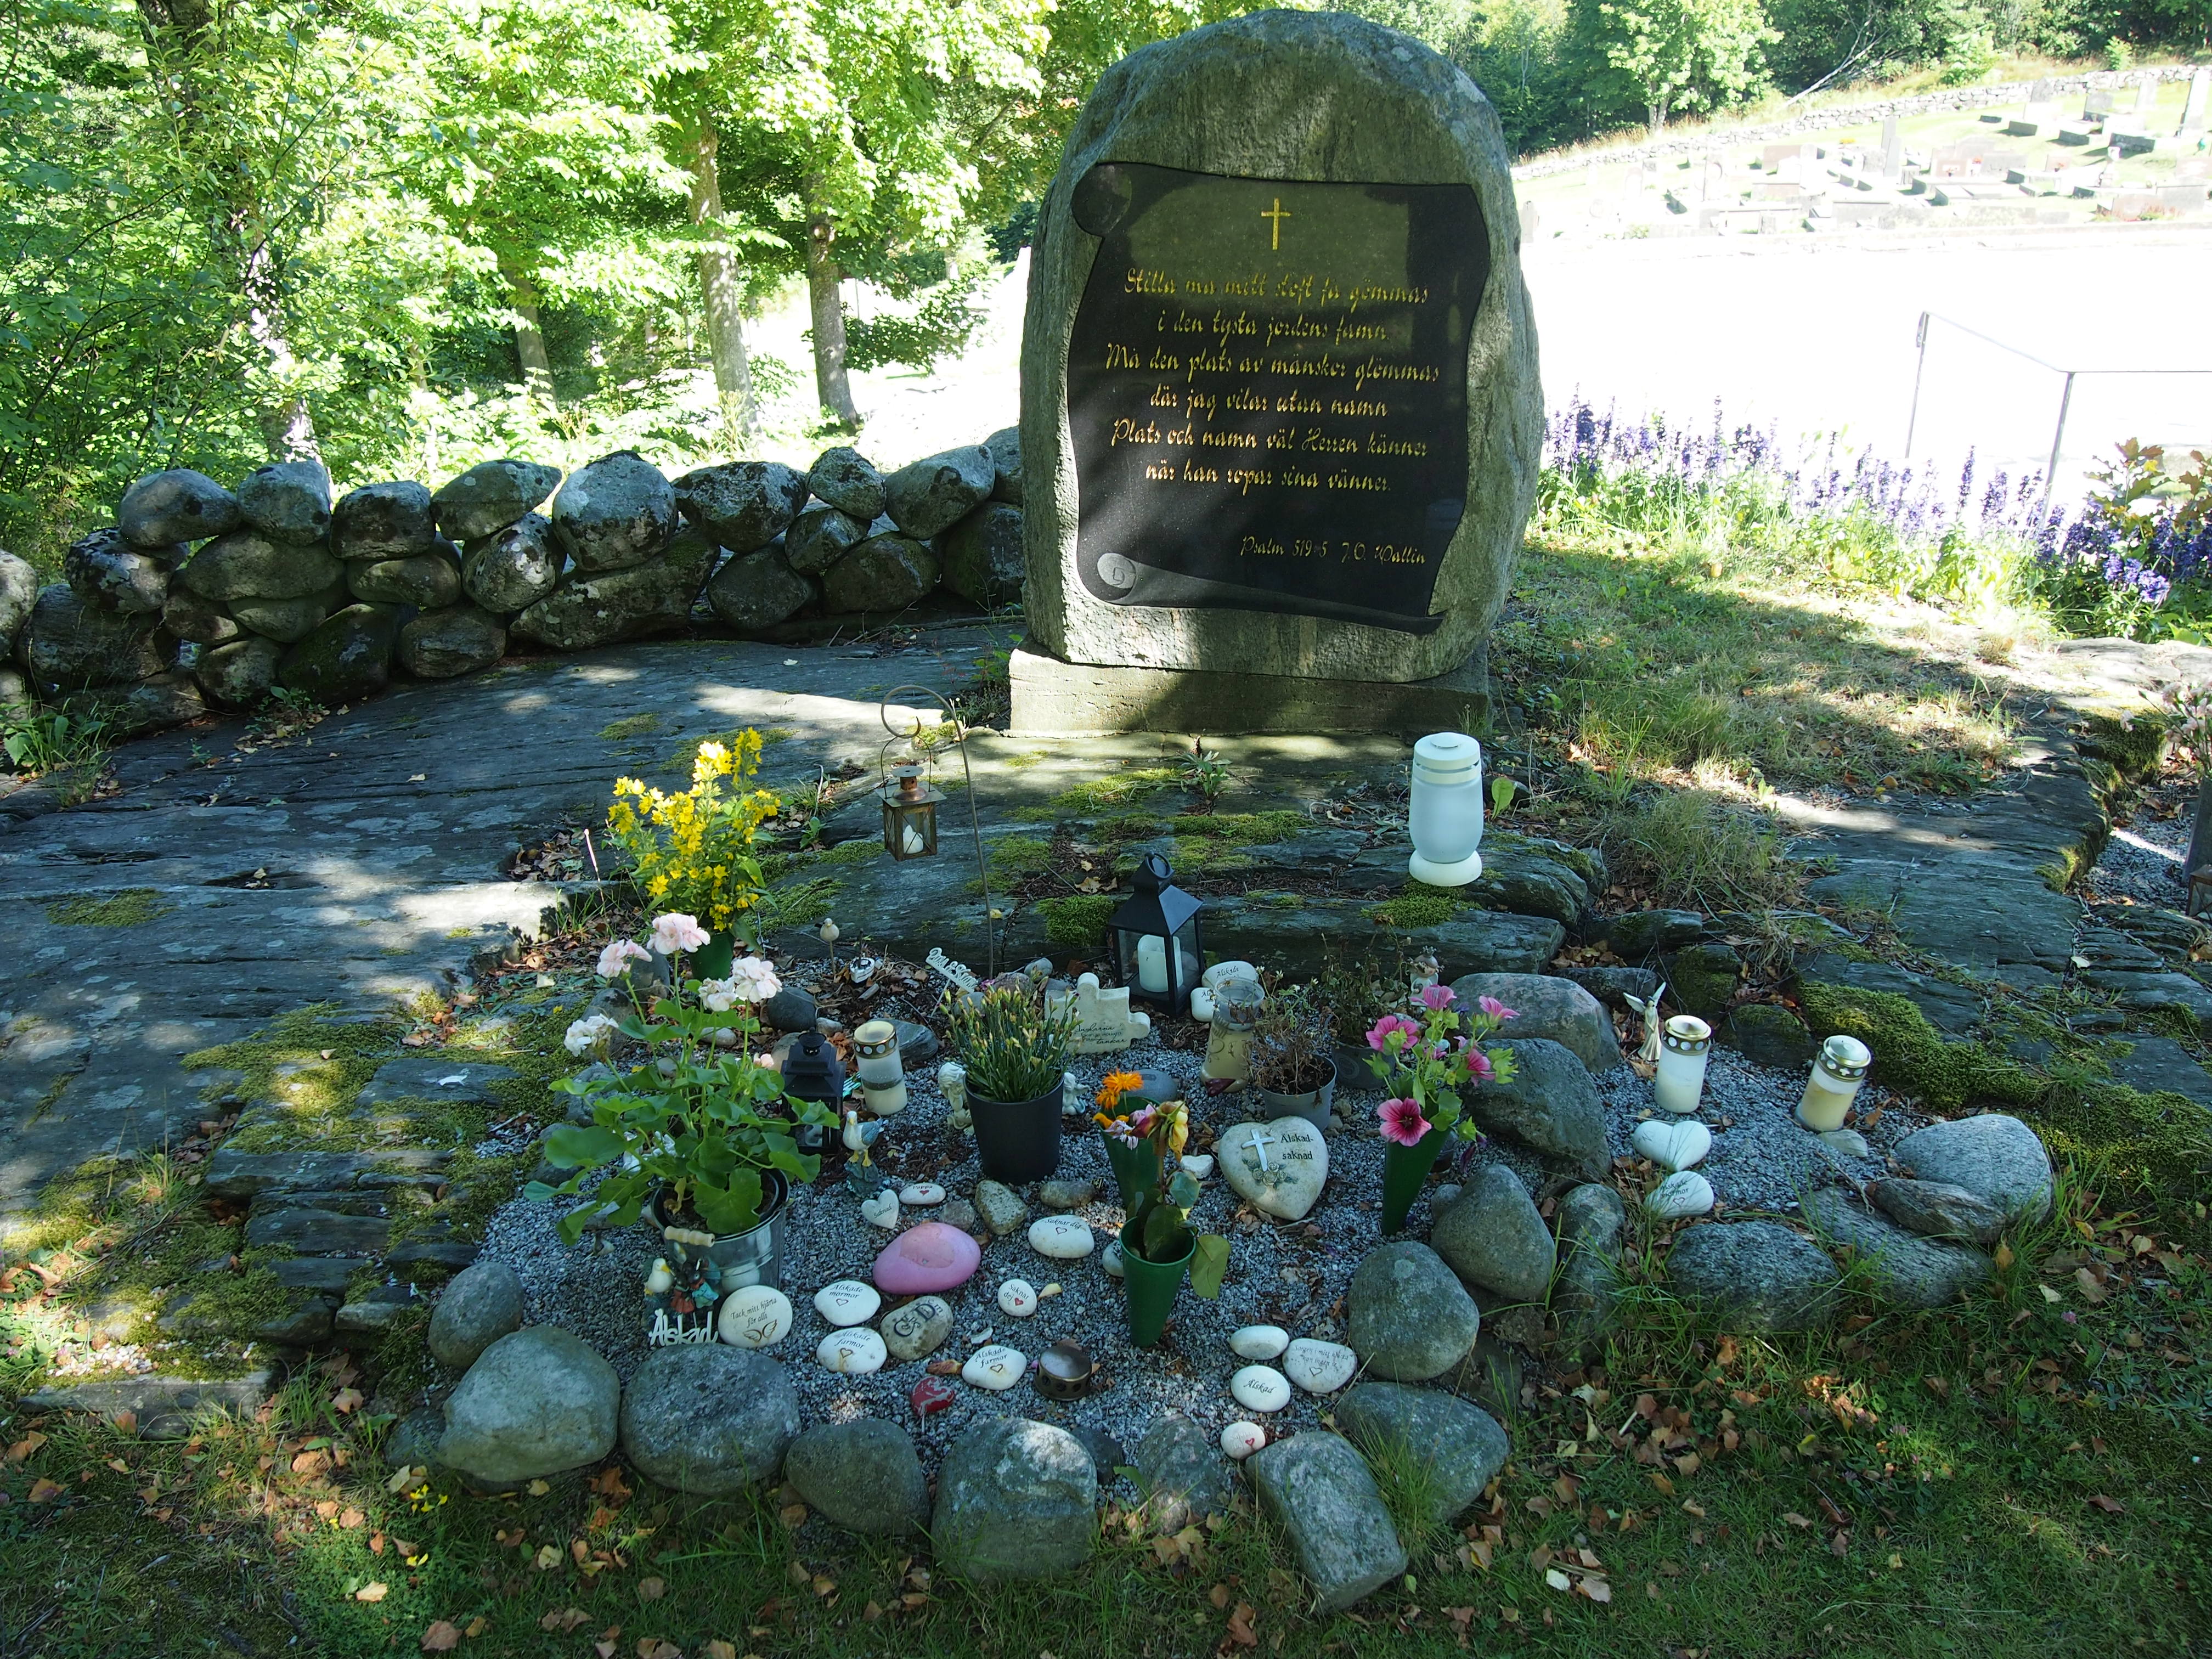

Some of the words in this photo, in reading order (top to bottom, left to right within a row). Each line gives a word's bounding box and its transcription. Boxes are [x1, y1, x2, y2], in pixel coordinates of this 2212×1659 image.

[1125, 268, 1177, 294] Stilla
[1225, 273, 1267, 296] mitt
[1349, 278, 1427, 314] gömmas
[1158, 309, 1166, 332] i
[1174, 308, 1203, 332] den
[1214, 309, 1257, 347] tysta
[1266, 313, 1328, 347] jordens
[1105, 342, 1141, 369] Må
[1150, 345, 1180, 370] den
[1187, 347, 1232, 383] plats
[1239, 357, 1263, 373] av
[1271, 353, 1346, 377] mänskor
[1355, 354, 1440, 392] glömmas
[1150, 383, 1178, 407] där
[1186, 388, 1217, 421] jag
[1227, 386, 1268, 411] vilar
[1277, 388, 1323, 413] utan
[1111, 418, 1161, 447] Plats
[1167, 421, 1194, 445] och
[1202, 432, 1257, 449] namn
[1266, 426, 1295, 450] väl
[1301, 427, 1359, 453] Herren
[1367, 431, 1427, 457] känner
[1146, 458, 1175, 481] när
[1183, 458, 1218, 482] han
[1227, 468, 1273, 496] ropar
[1281, 465, 1319, 488] sina
[1328, 469, 1391, 491] vänner.
[1240, 535, 1285, 556] Psalm
[1374, 545, 1426, 565] Wallin
[1282, 1150, 1313, 1160] saknad
[1003, 1291, 1014, 1301] dej
[1008, 1284, 1029, 1300] Saknar
[731, 1308, 747, 1320] Tack
[747, 1305, 759, 1314] mitt
[760, 1297, 777, 1311] hjärta
[747, 1317, 757, 1328] för
[758, 1311, 768, 1322] allt
[834, 1338, 865, 1348] farmor
[980, 1354, 1007, 1369] farmor
[1243, 1379, 1277, 1394] Älskad
